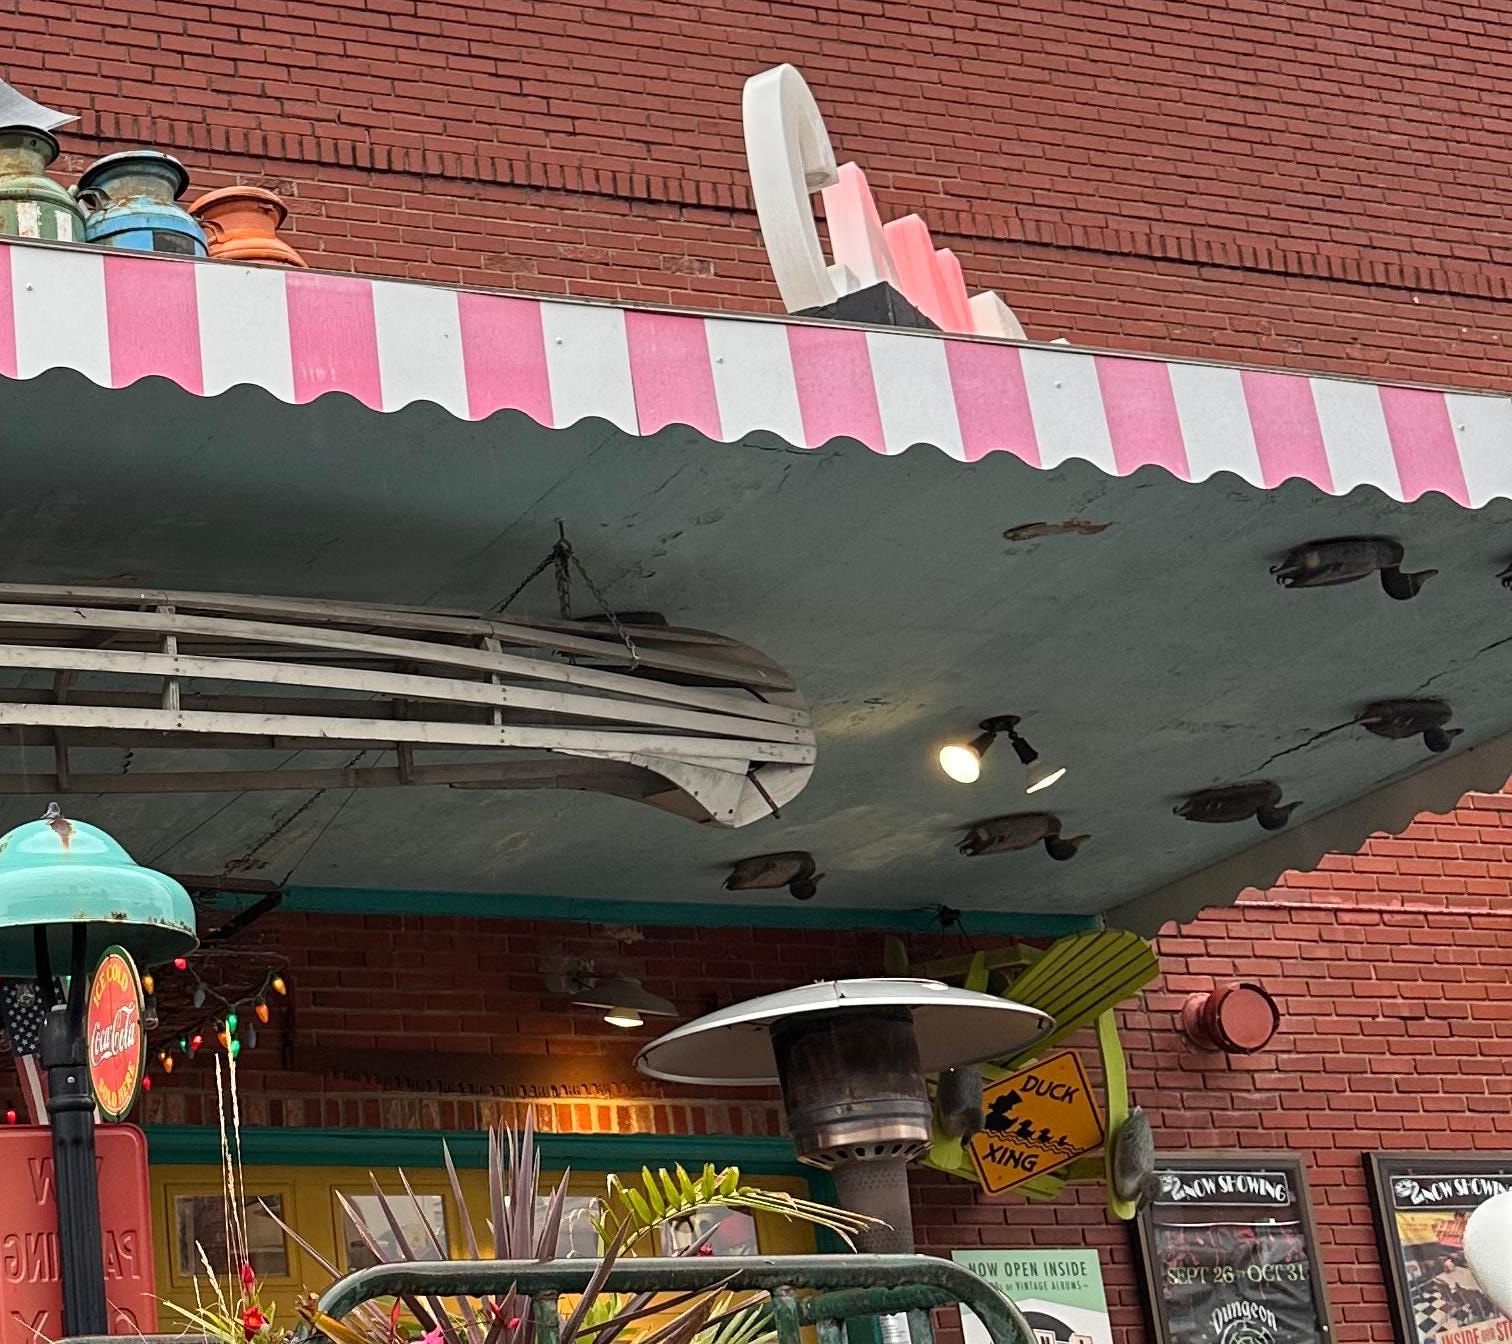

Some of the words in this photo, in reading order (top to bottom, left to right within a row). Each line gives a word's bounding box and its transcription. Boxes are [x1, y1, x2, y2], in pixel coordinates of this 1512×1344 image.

[93, 970, 105, 1008] ICE
[107, 963, 130, 992] COLD
[99, 1077, 118, 1107] SOLD
[117, 1060, 136, 1104] HERE
[1020, 1075, 1080, 1105] DUCK
[982, 1143, 1040, 1172] XING
[1183, 1177, 1217, 1201] NOW
[1218, 1174, 1286, 1202] SHOWING
[968, 1262, 998, 1278] NOW
[1004, 1262, 1039, 1277] OPEN
[1043, 1261, 1088, 1276] INSIDE
[1167, 1266, 1209, 1285] SEPT
[1213, 1265, 1234, 1283] 26
[1247, 1264, 1284, 1283] OCT
[1287, 1264, 1306, 1281] 31
[1211, 1300, 1278, 1336] Dungeon
